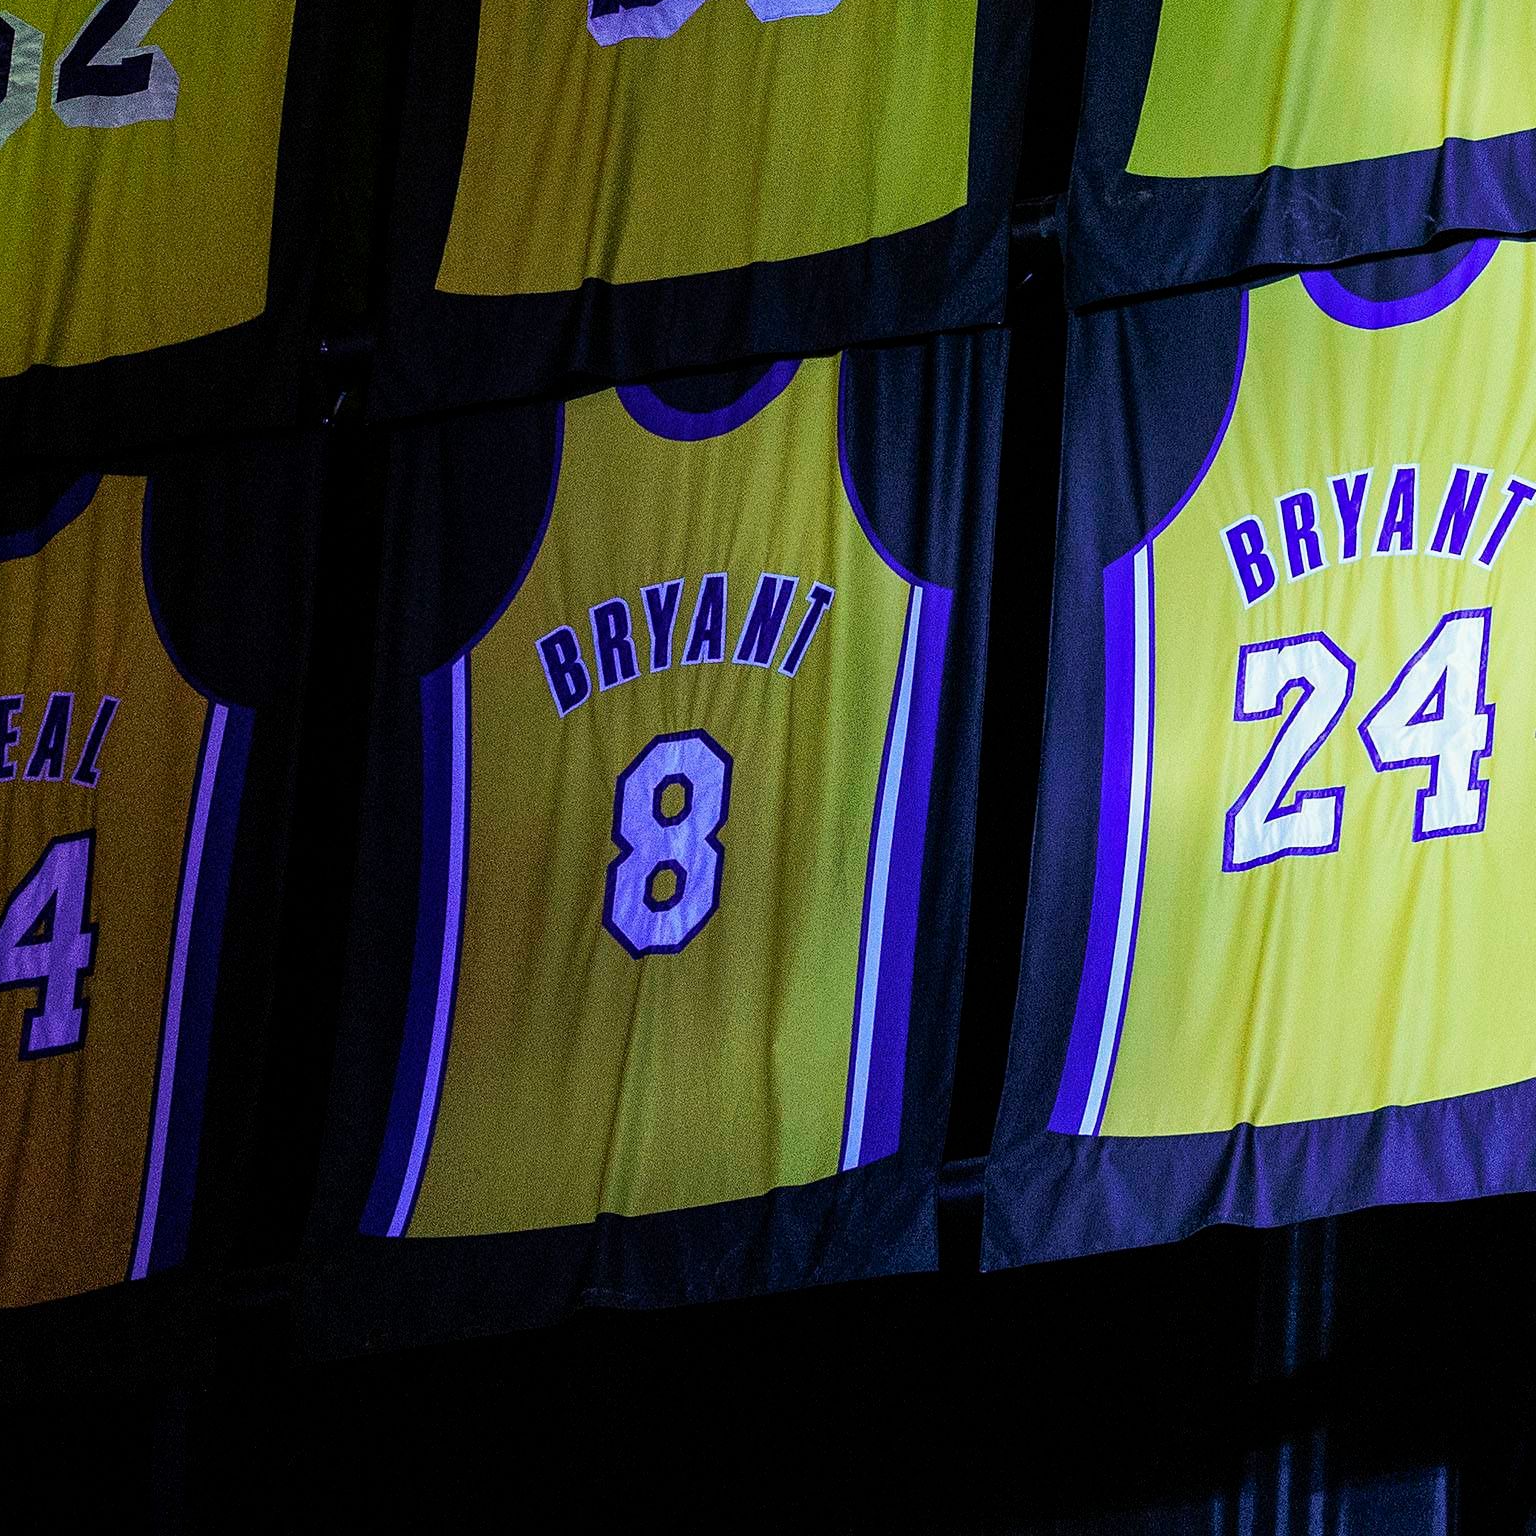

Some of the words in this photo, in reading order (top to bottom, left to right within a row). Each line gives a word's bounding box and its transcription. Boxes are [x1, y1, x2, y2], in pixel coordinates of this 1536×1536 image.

[535, 571, 836, 719] BRYANT
[1222, 606, 1496, 873] 24
[602, 728, 733, 959] 8
